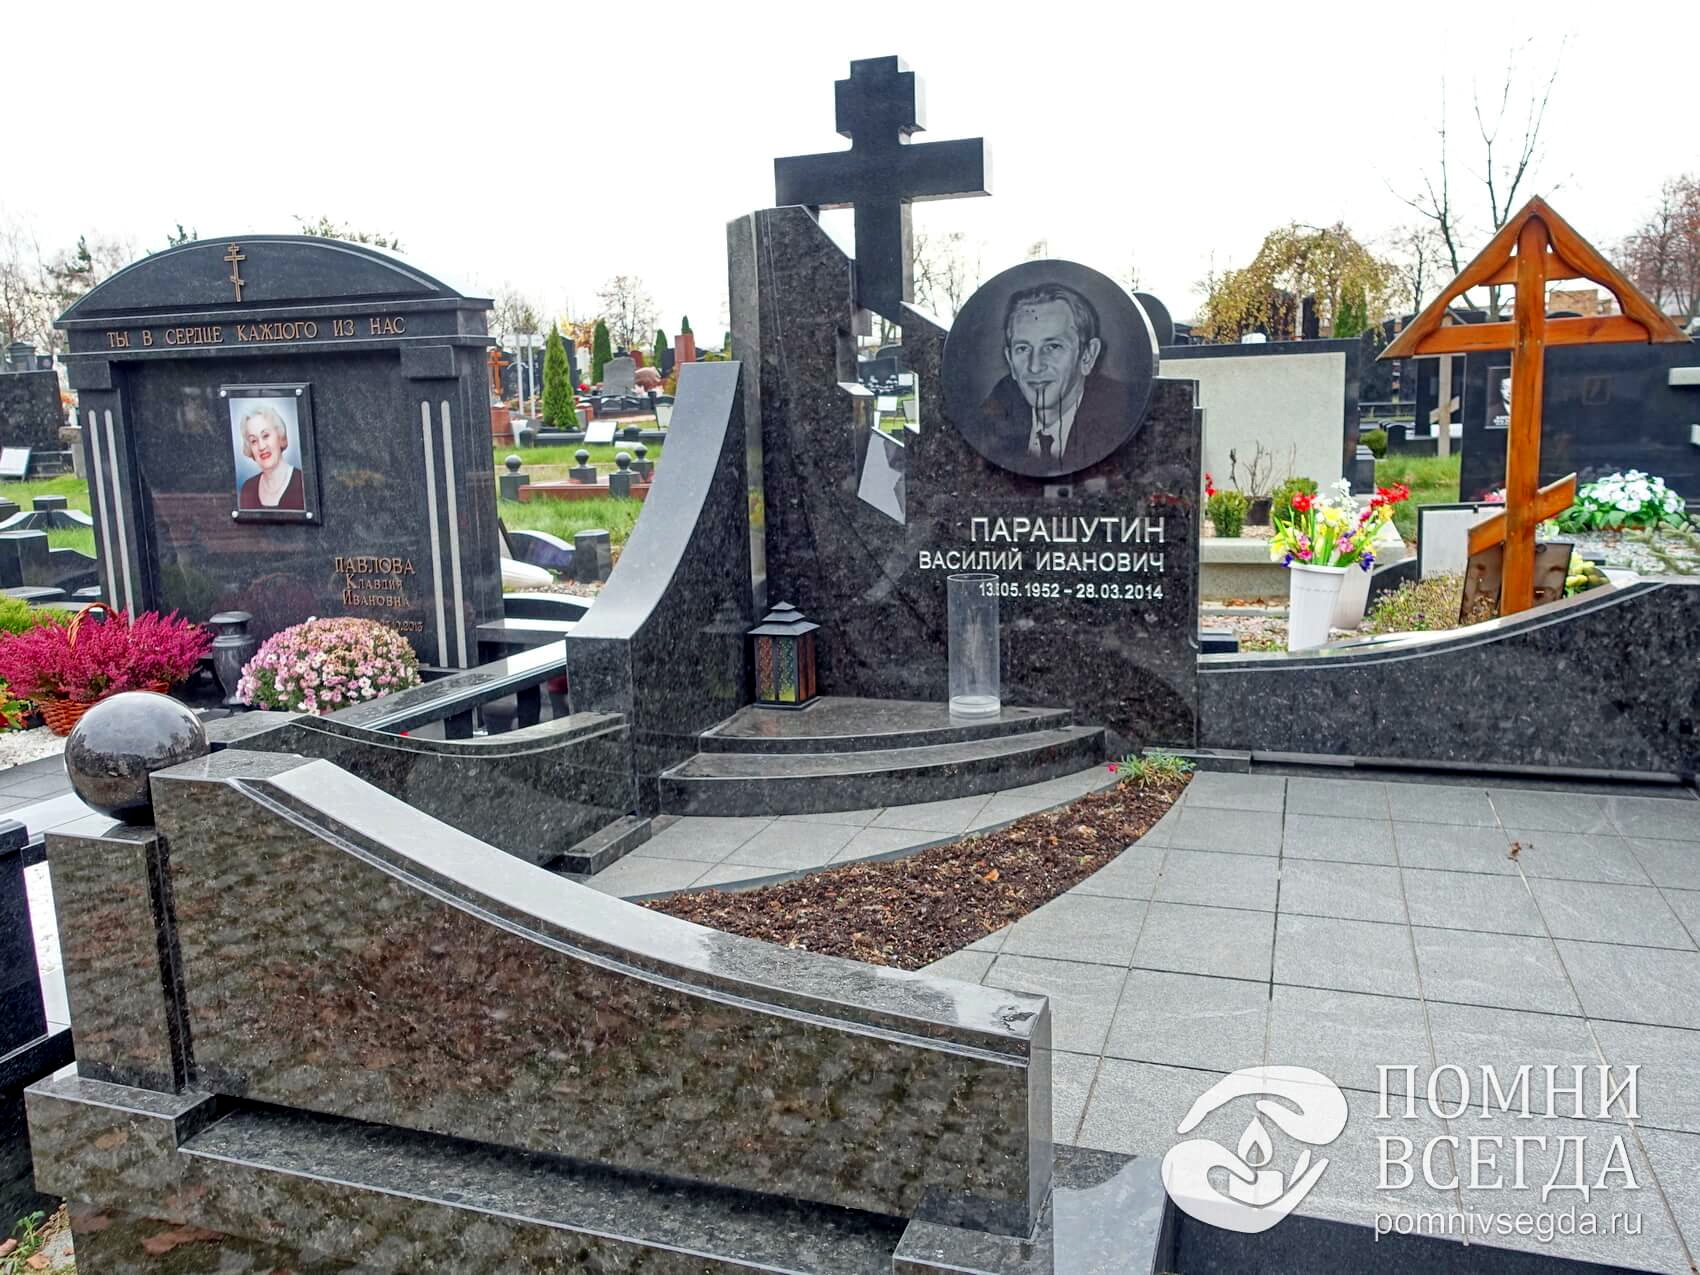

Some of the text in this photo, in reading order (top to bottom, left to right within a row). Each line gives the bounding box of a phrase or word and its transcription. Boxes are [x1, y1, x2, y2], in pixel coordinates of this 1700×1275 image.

[107, 317, 406, 348] ТЫ В СЕРДЦЕ КАЖДОГО ИЗ НАС
[971, 517, 1165, 543] ПАРАШУТИН
[335, 557, 416, 575] ПАВЛОВА
[919, 548, 1165, 572] ВАСИЛИЙ ИВАНОВИЧ
[979, 582, 1061, 598] 13.05.1952
[1076, 583, 1163, 600] 28.03.2014
